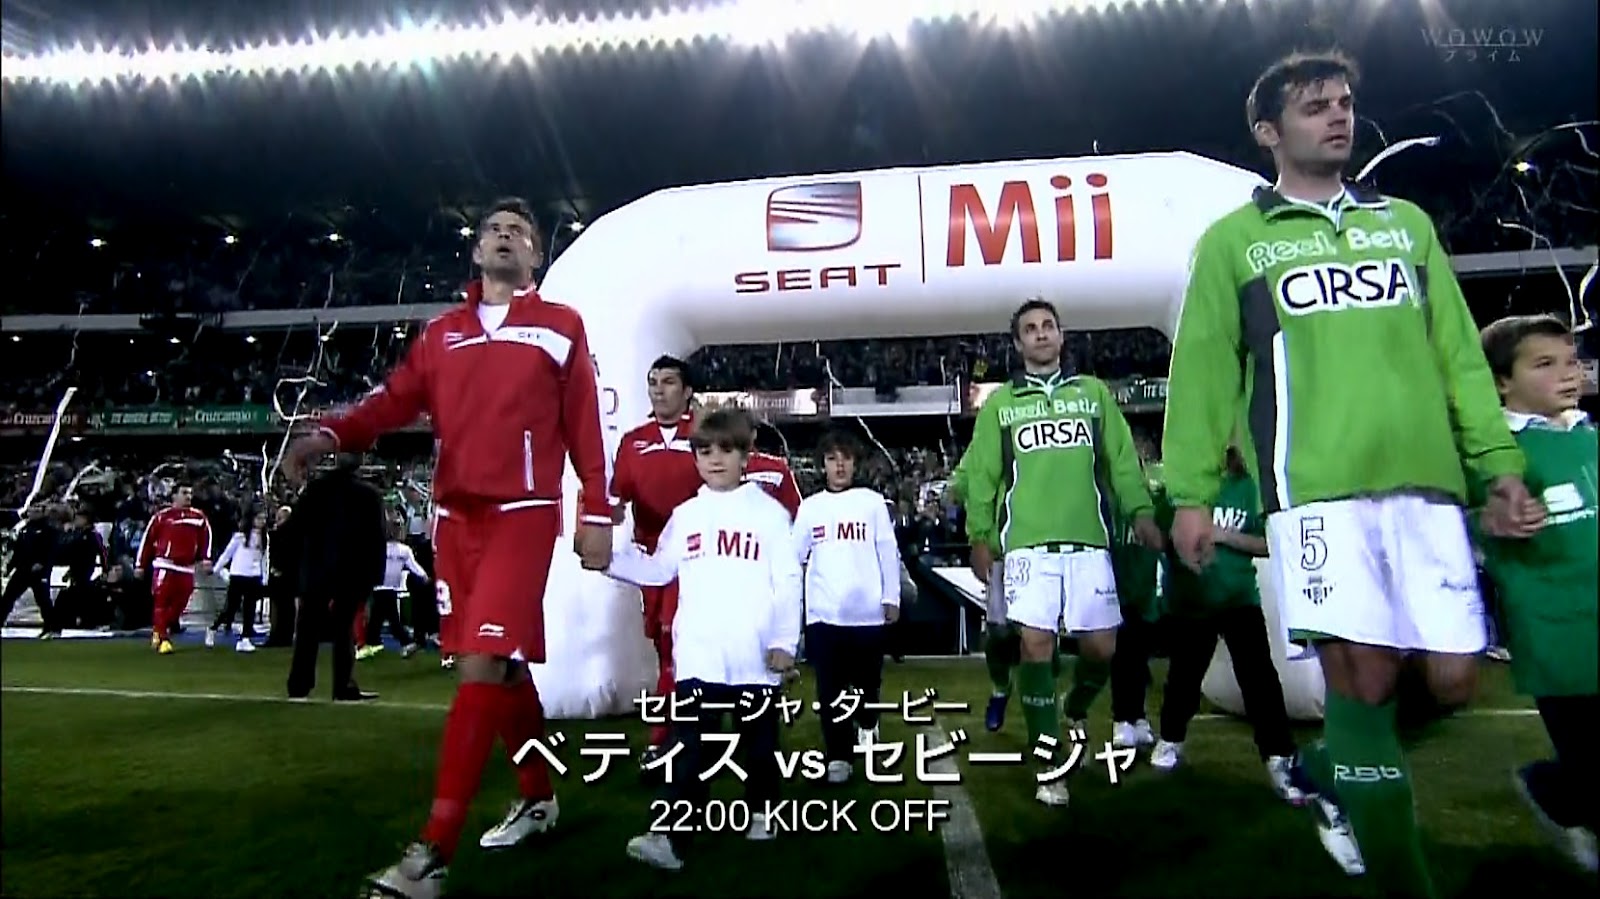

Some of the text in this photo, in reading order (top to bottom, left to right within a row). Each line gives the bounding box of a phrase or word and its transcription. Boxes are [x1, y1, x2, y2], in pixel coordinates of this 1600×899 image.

[946, 173, 1113, 267] Mii
[735, 263, 901, 293] SEAT
[1280, 261, 1412, 311] CIRSA
[1017, 420, 1092, 450] CIRSA
[837, 522, 867, 541] Mii
[1213, 506, 1248, 529] Mii
[717, 529, 760, 561] Mii
[1300, 516, 1328, 571] 5
